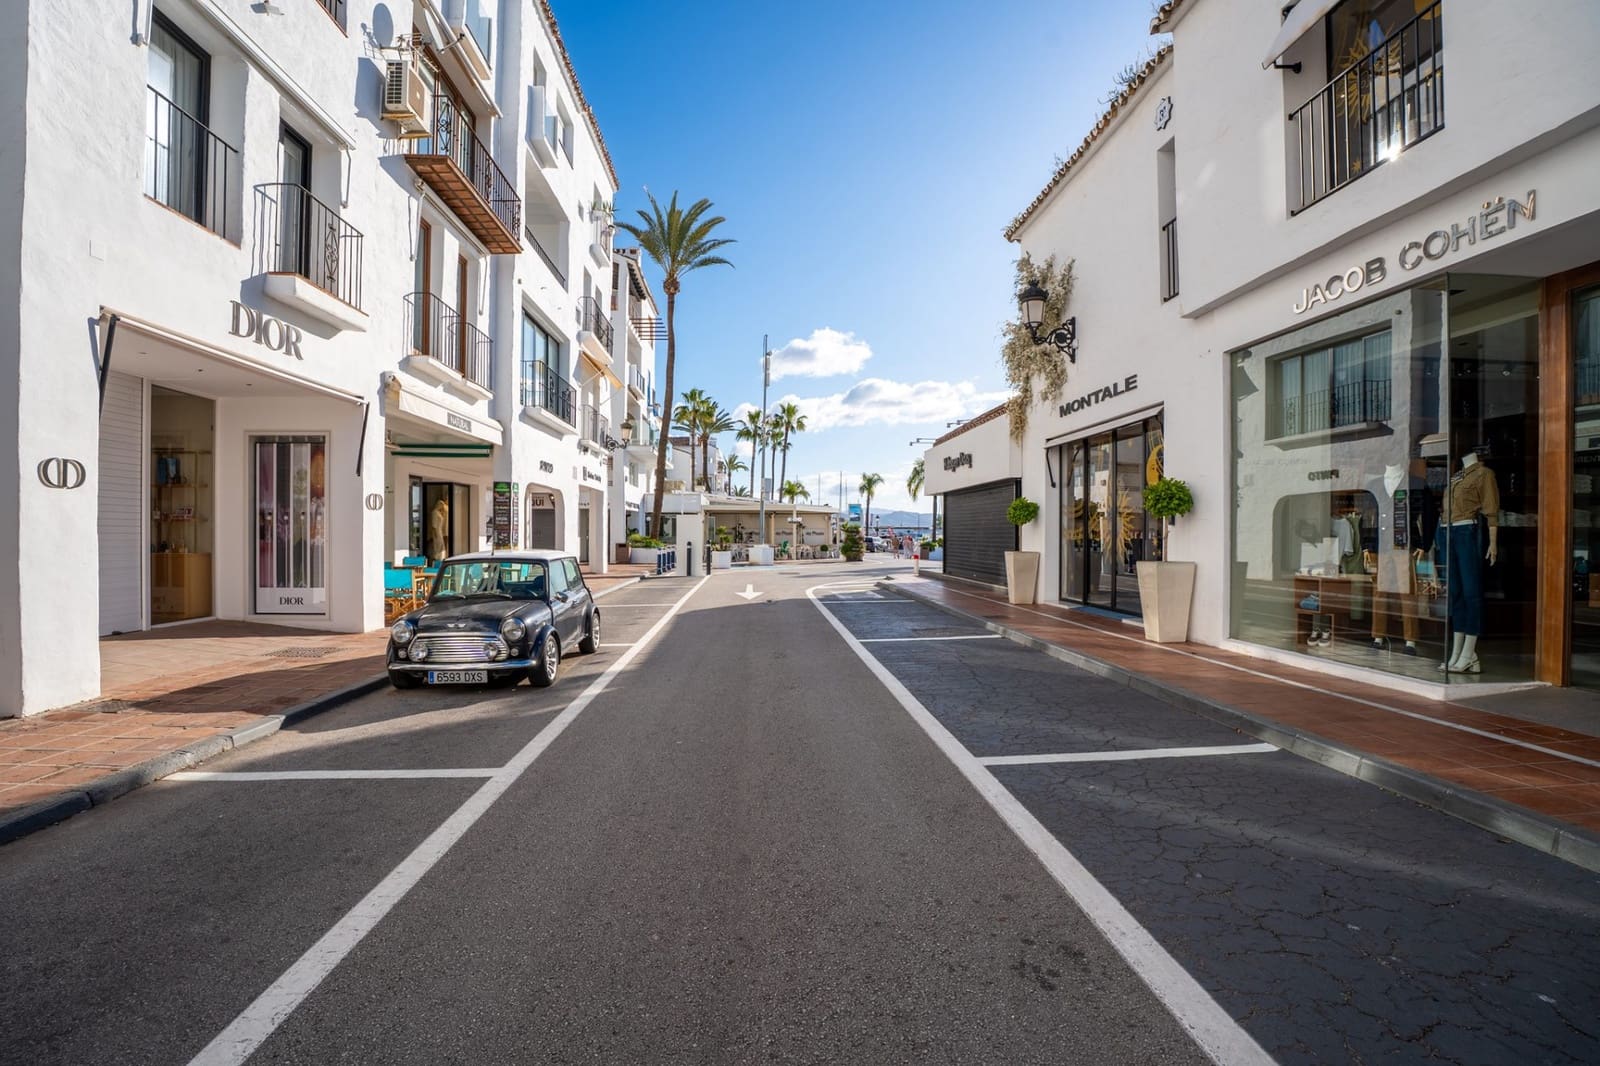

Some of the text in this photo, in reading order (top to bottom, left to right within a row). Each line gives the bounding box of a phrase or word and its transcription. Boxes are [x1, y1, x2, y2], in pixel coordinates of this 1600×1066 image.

[1293, 189, 1537, 314] JACOB COHËN
[228, 300, 304, 361] DIOR
[1059, 374, 1138, 418] MONTALE
[279, 596, 304, 605] DIOR
[437, 672, 483, 682] 6593 DXS
